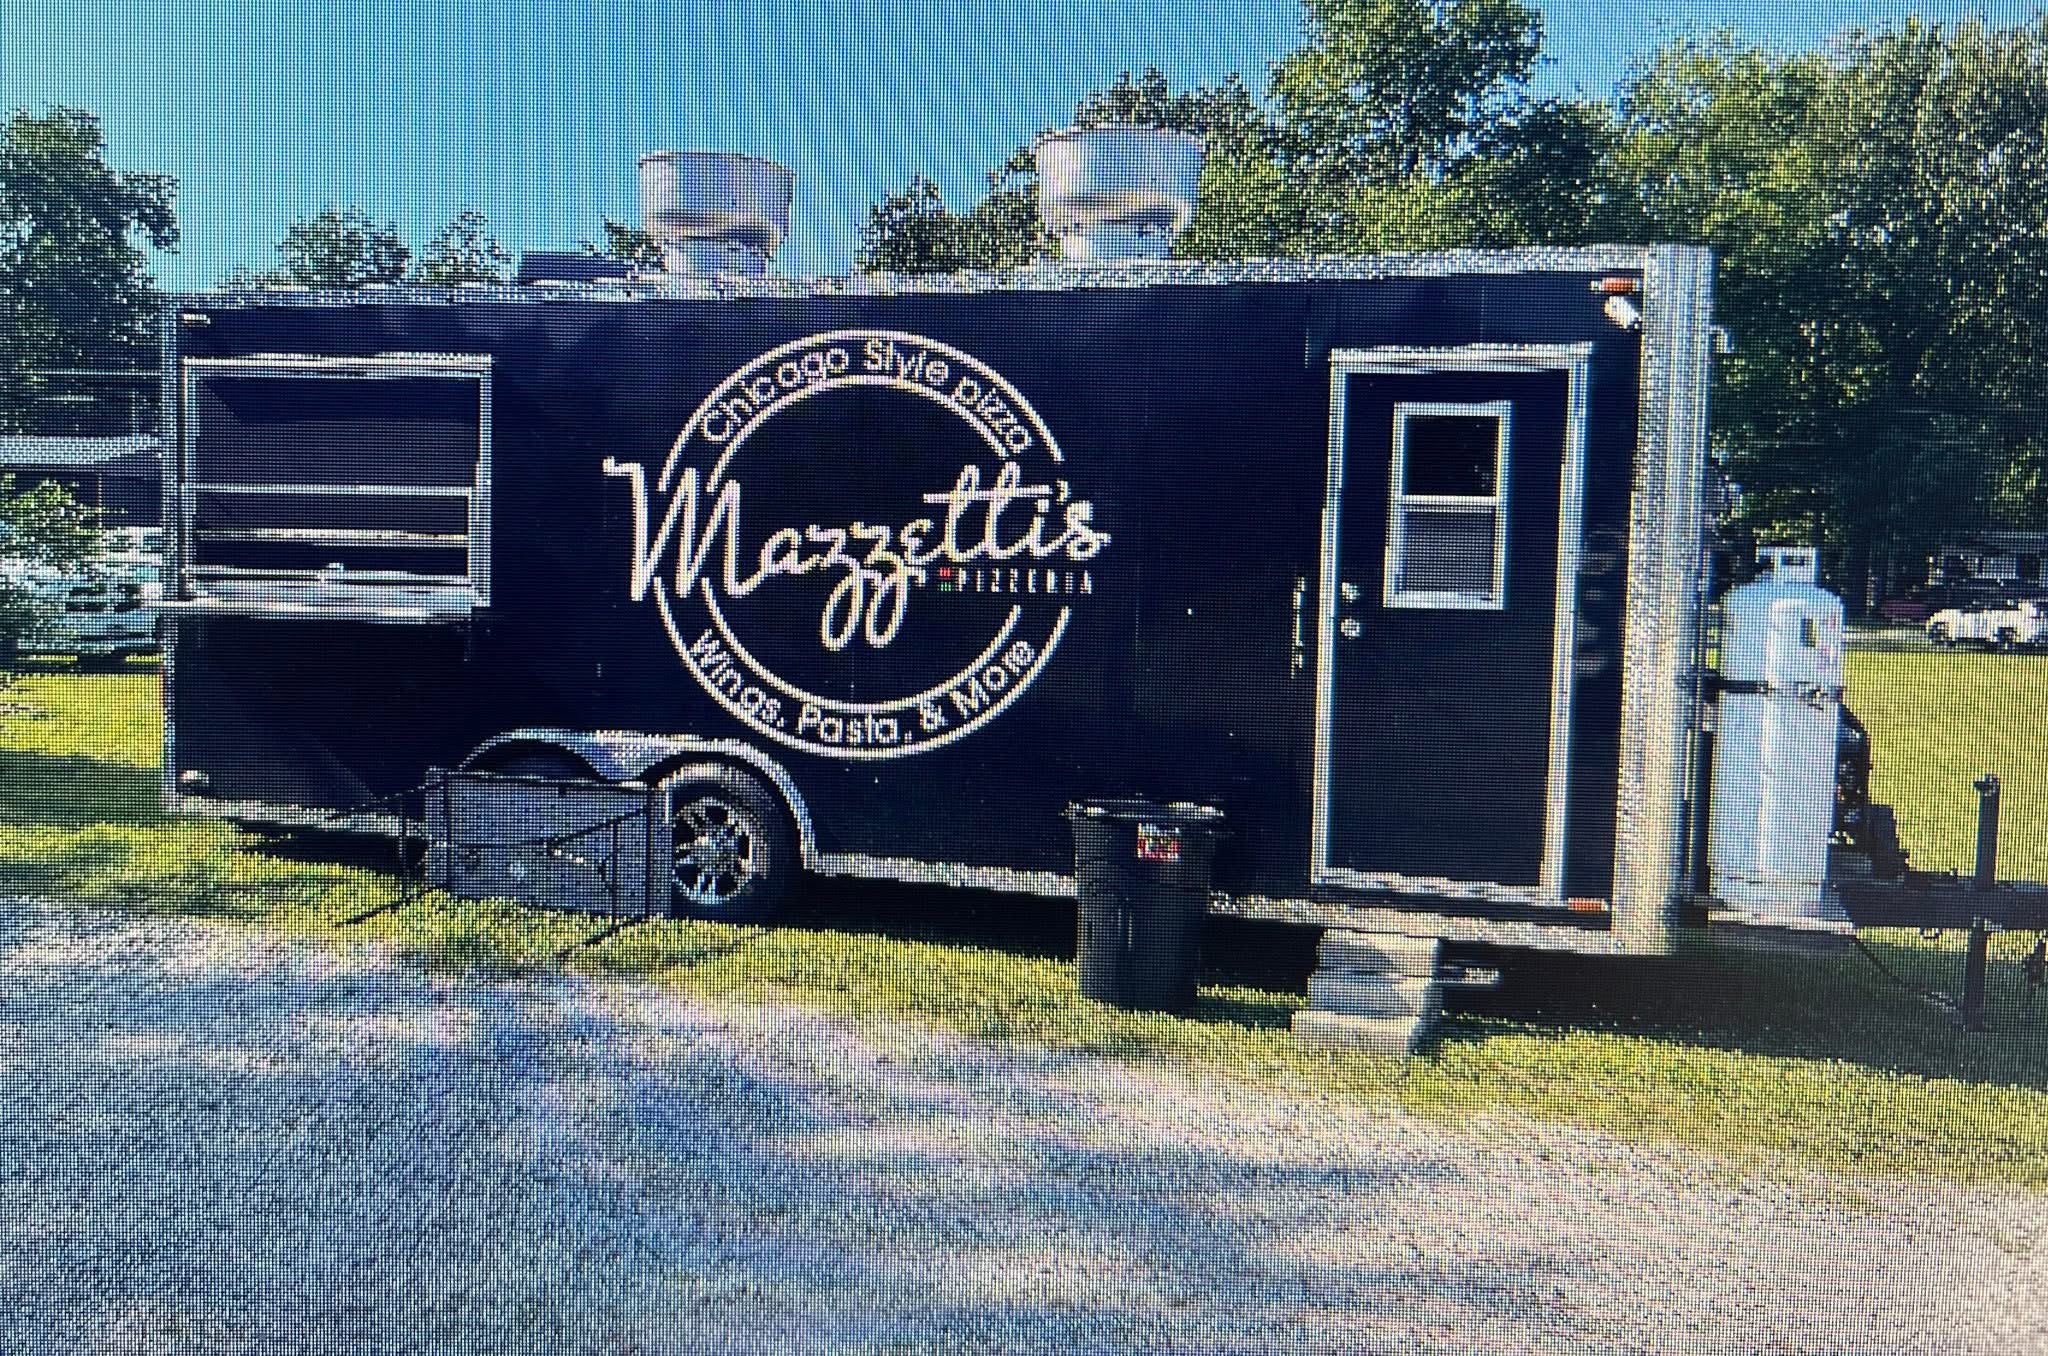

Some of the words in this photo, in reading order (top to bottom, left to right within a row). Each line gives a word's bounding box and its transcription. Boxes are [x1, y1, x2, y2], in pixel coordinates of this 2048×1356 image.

[703, 347, 849, 443] Chicago
[863, 338, 950, 386] Style
[954, 376, 1033, 454] pizza
[602, 455, 1113, 652] Mazzetti's
[956, 567, 1093, 595] PIZZERIA
[918, 698, 949, 733] &
[949, 640, 1036, 720] More
